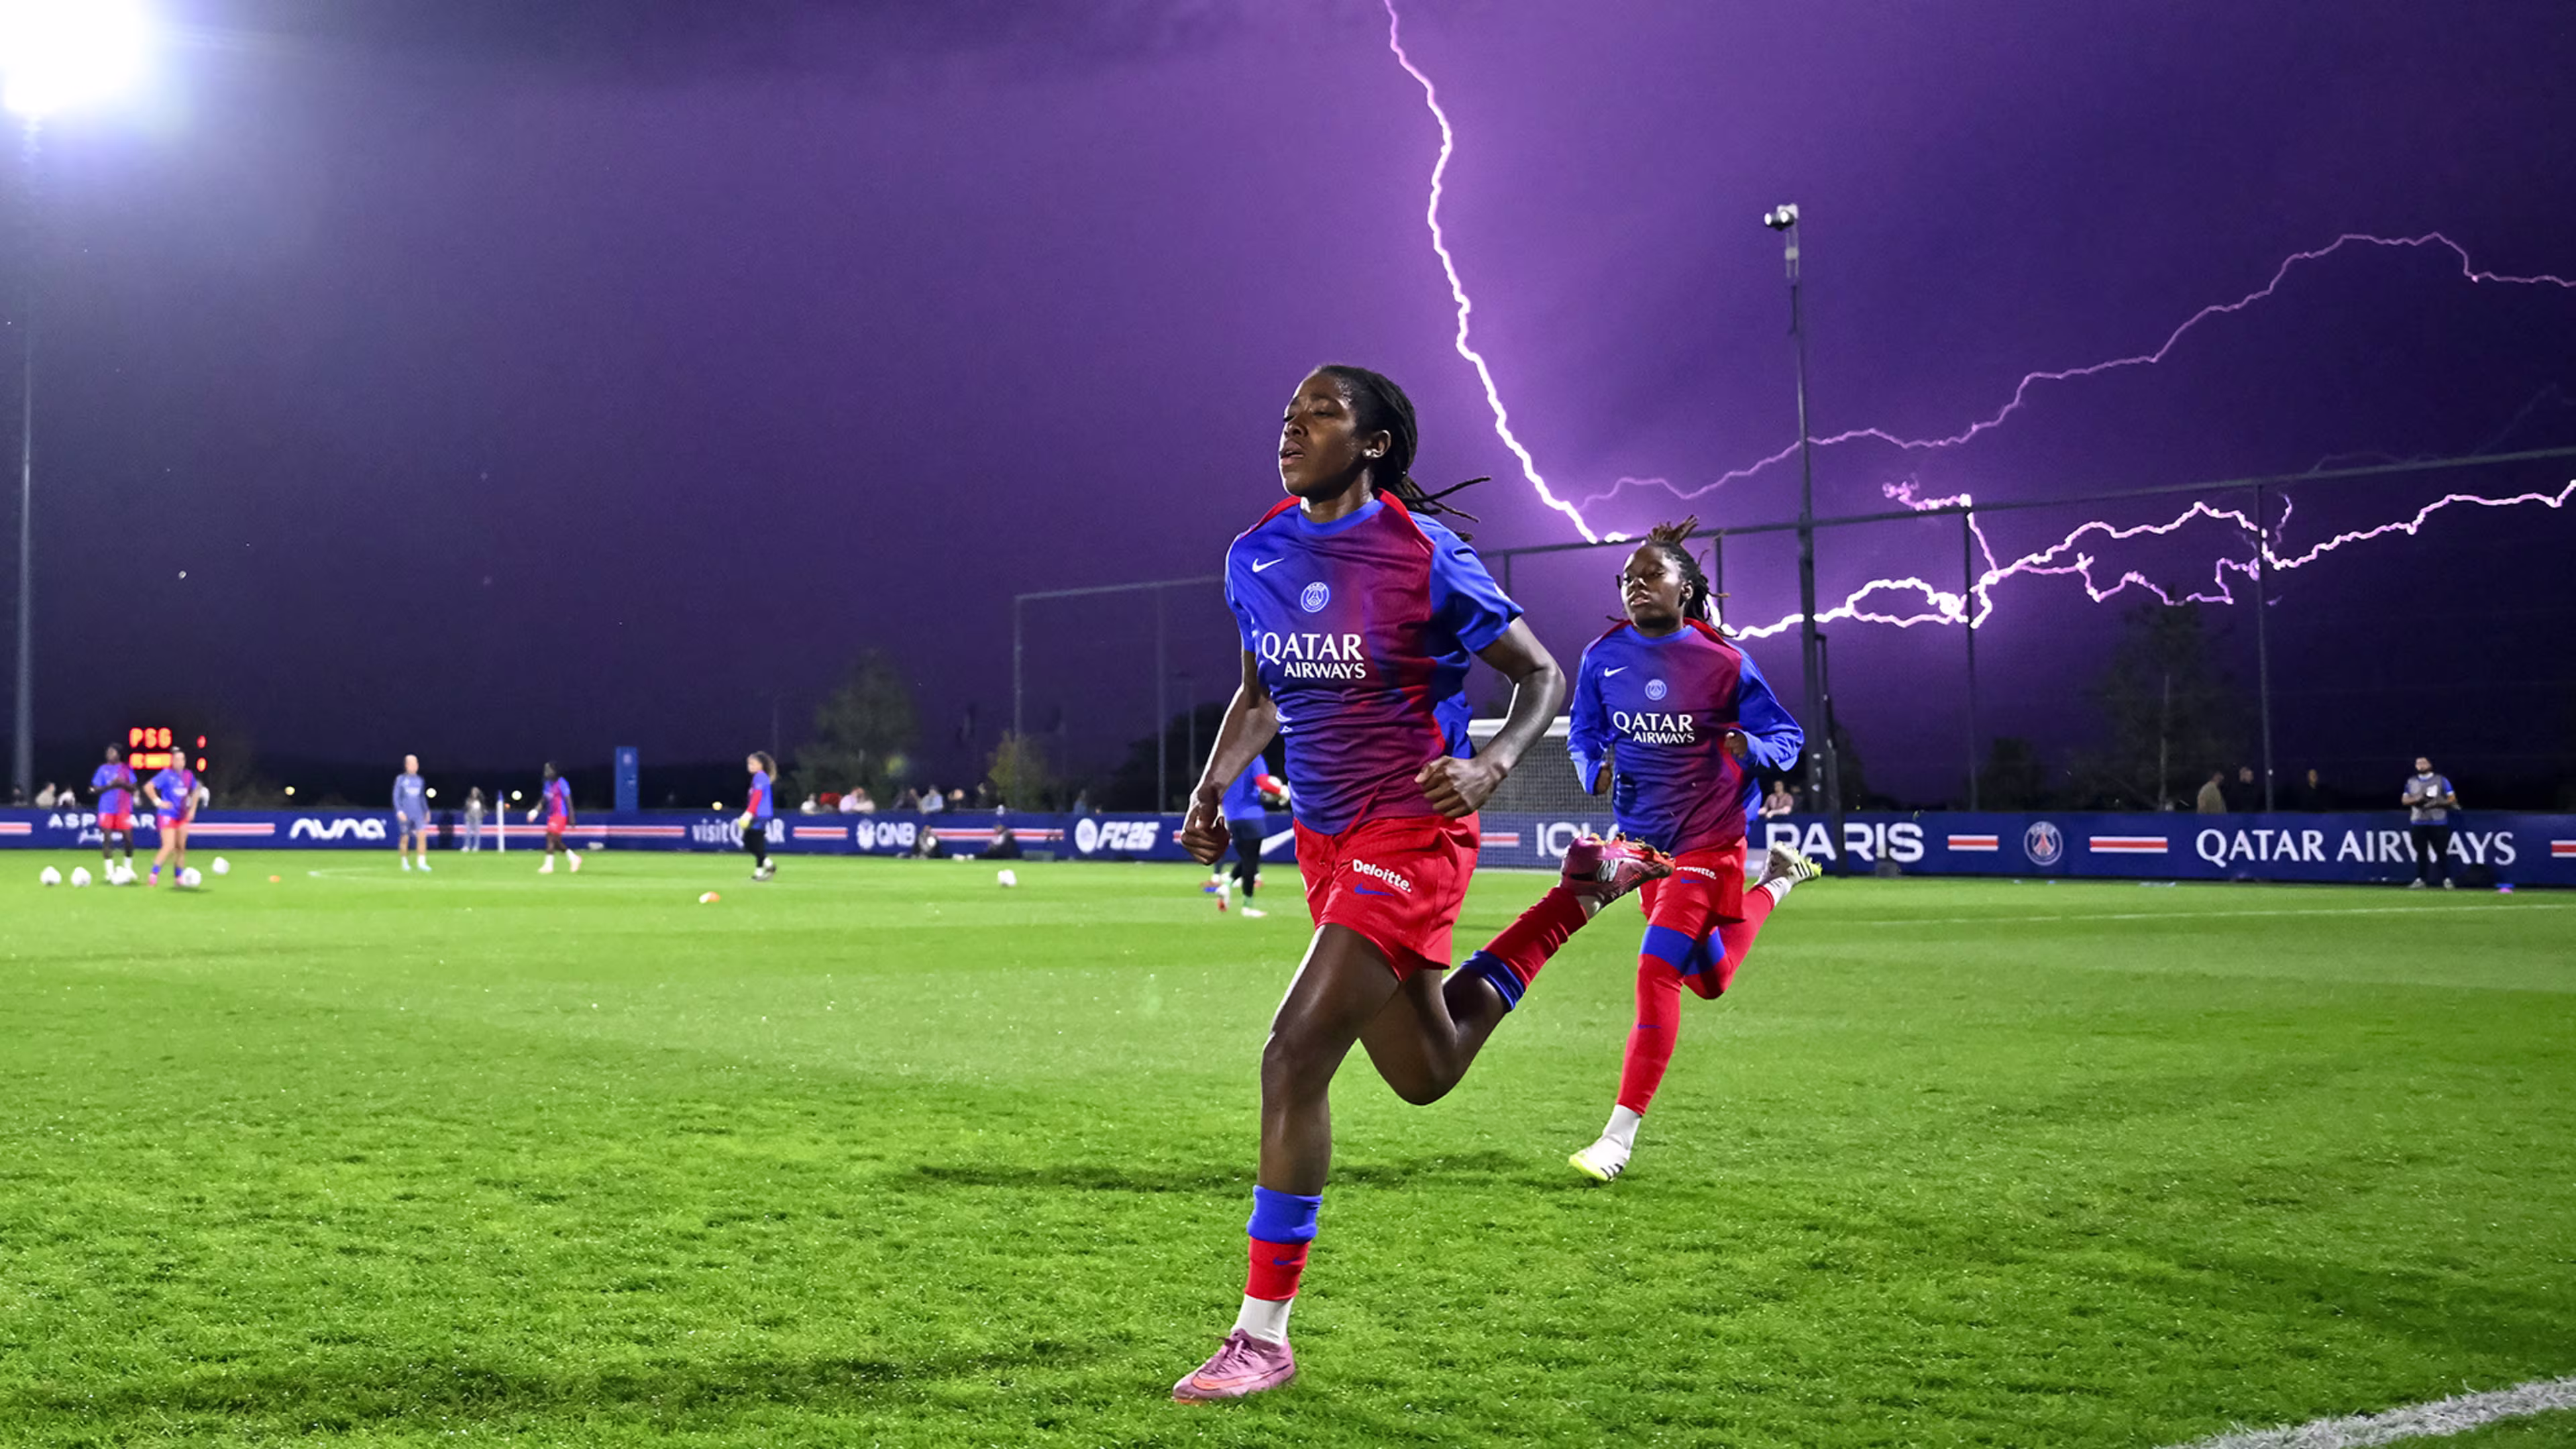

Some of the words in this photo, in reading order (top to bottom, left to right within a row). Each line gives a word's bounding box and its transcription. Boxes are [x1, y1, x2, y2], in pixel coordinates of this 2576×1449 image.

[1262, 632, 1364, 665] QATAR
[1284, 661, 1366, 679] AIRWAYS
[1613, 711, 1693, 734] QATAR
[129, 727, 172, 749] PSG
[1633, 731, 1695, 743] AIRWAYS
[48, 813, 157, 829] ASPAR
[692, 818, 785, 847] visitQAR
[876, 822, 916, 847] QNB
[1096, 821, 1161, 851] FC26
[1766, 822, 1924, 862] PARIS
[2196, 828, 2326, 867] QATAR
[1353, 859, 1411, 893] Deloitte.
